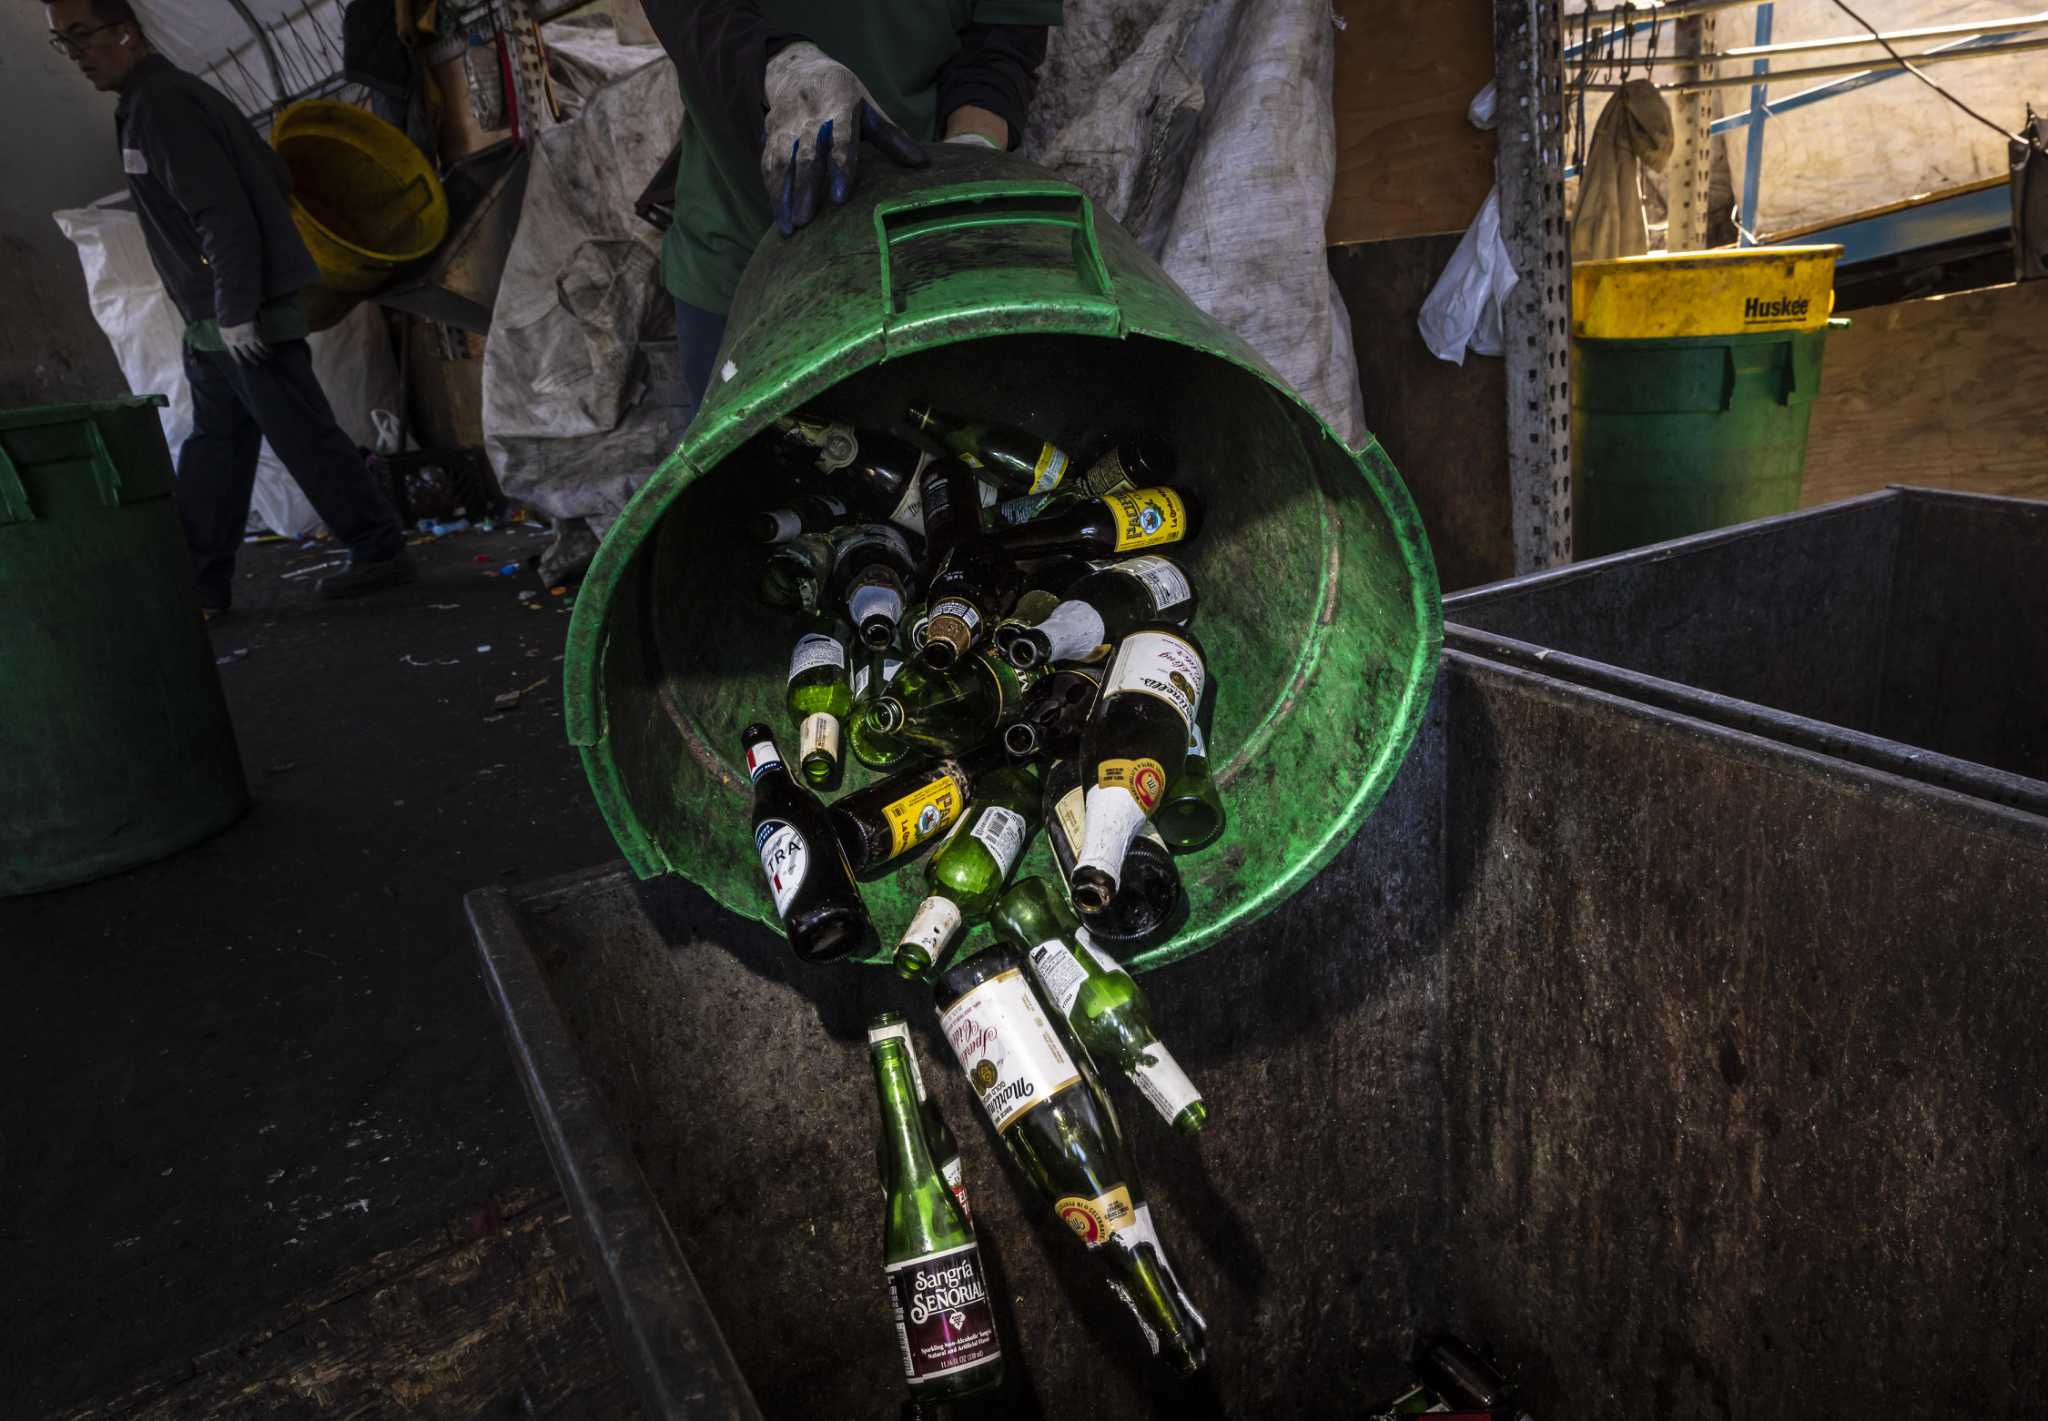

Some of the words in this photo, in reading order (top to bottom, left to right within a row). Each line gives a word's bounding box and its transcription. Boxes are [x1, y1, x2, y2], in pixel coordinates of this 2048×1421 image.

[767, 840, 802, 873] TRA
[915, 1259, 974, 1291] Sangría
[910, 1281, 985, 1325] SEÑORIAL
[921, 1343, 945, 1355] Sparkling
[928, 1350, 947, 1360] Natural
[948, 1346, 957, 1355] and
